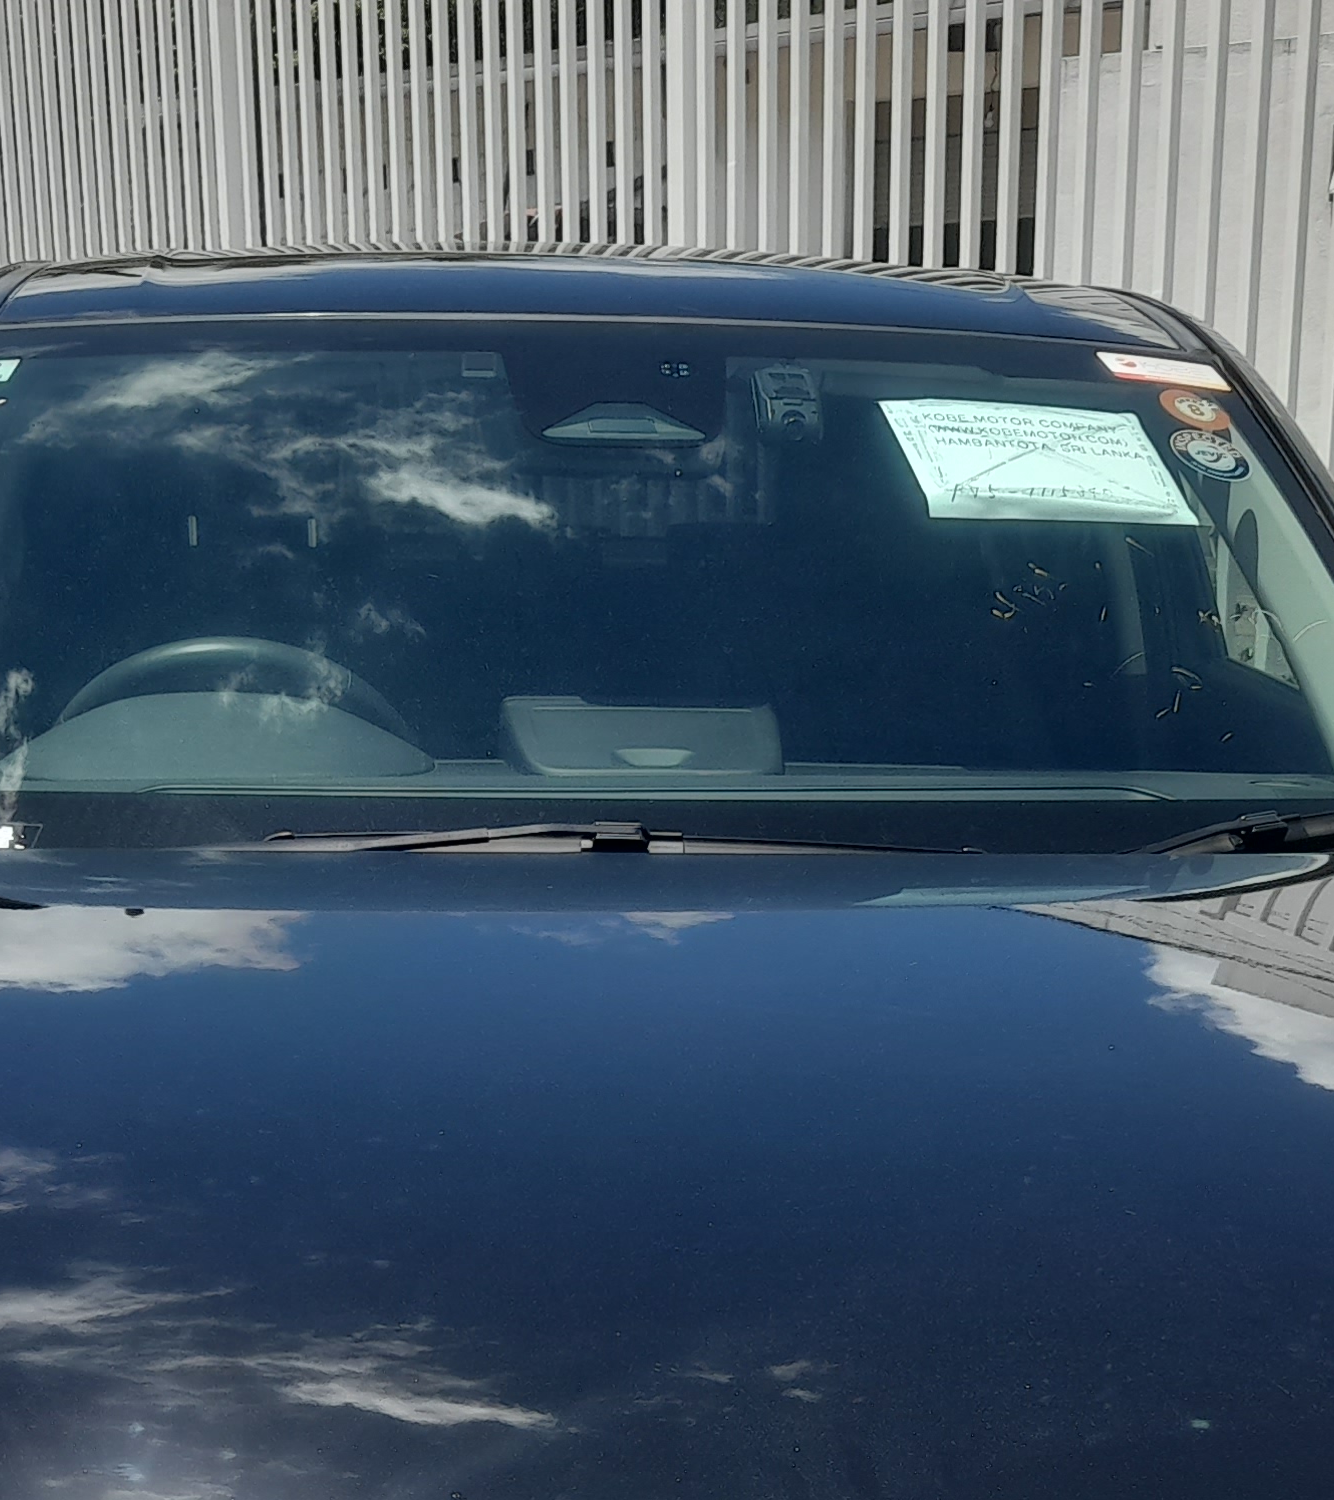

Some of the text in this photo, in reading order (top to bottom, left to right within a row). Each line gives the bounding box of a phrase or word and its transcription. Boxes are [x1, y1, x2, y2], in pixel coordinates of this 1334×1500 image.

[922, 413, 1117, 433] KOBE MOTOR COMPANY
[1092, 448, 1145, 460] LANKA
